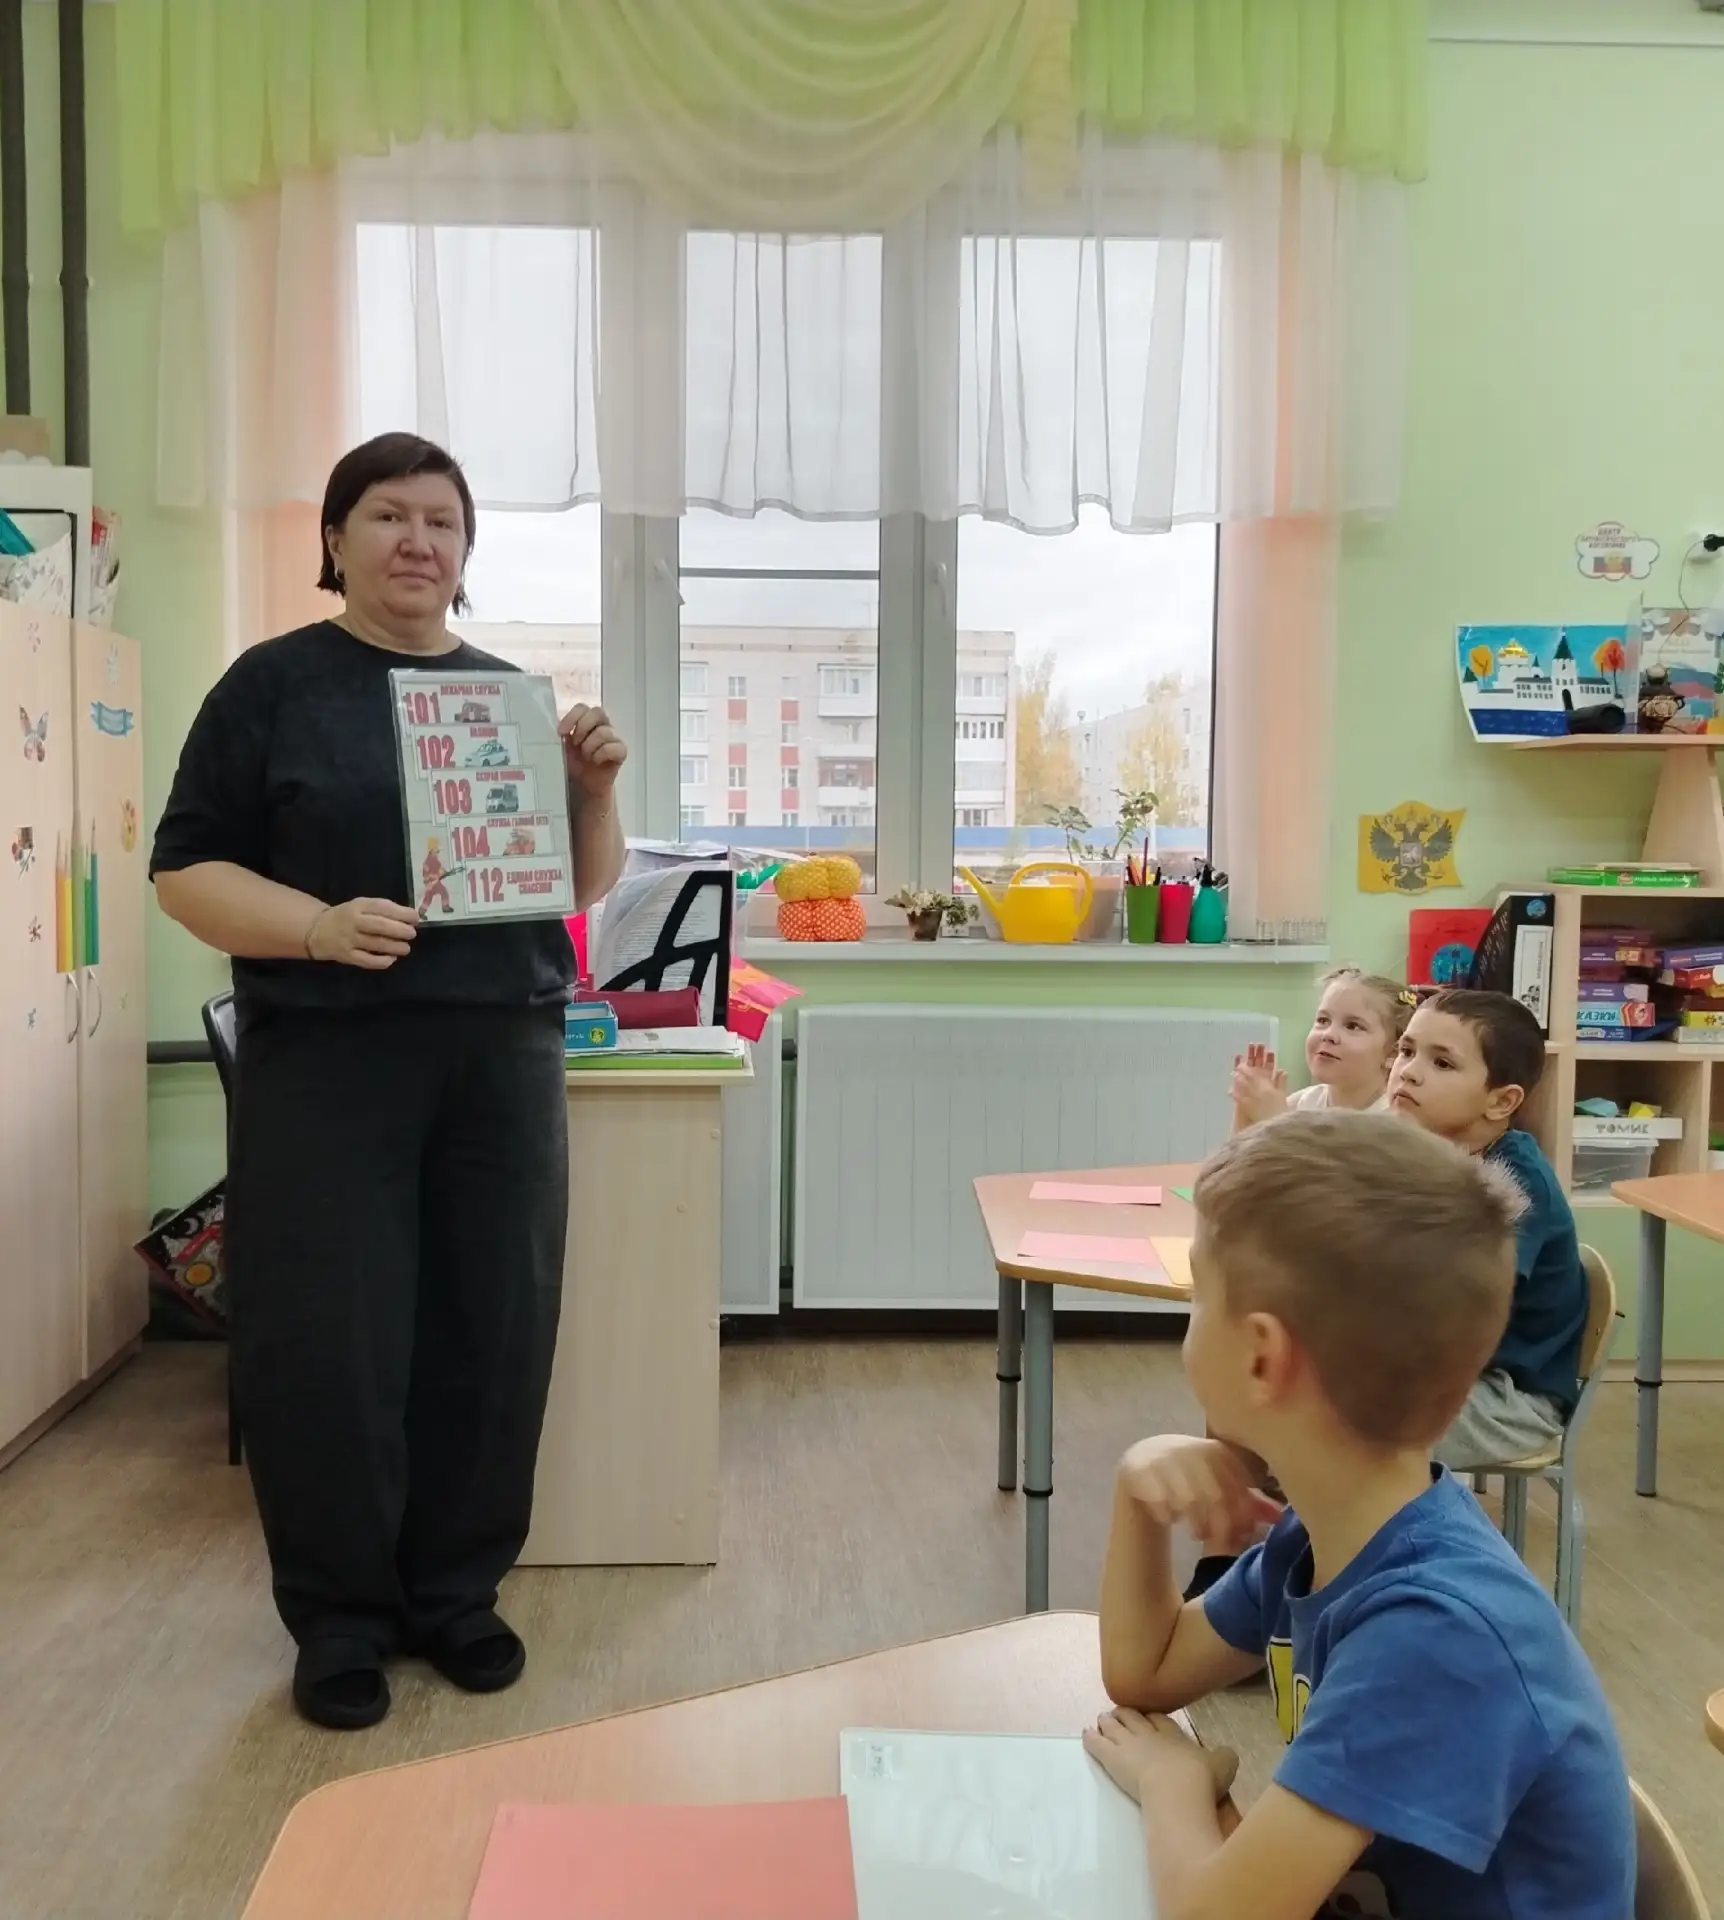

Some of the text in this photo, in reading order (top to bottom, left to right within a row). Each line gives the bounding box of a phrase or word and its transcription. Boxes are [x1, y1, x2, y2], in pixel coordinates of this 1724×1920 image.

[474, 684, 501, 695] СЛУЖБА
[403, 691, 442, 724] 101
[416, 734, 456, 769] 102
[432, 778, 473, 815] 103
[451, 826, 491, 861] 104
[467, 867, 505, 903] 112
[534, 868, 563, 881] СЛУЖБА
[1576, 1010, 1617, 1022] КАЗКИ
[1595, 1123, 1650, 1134] ТОМИК
